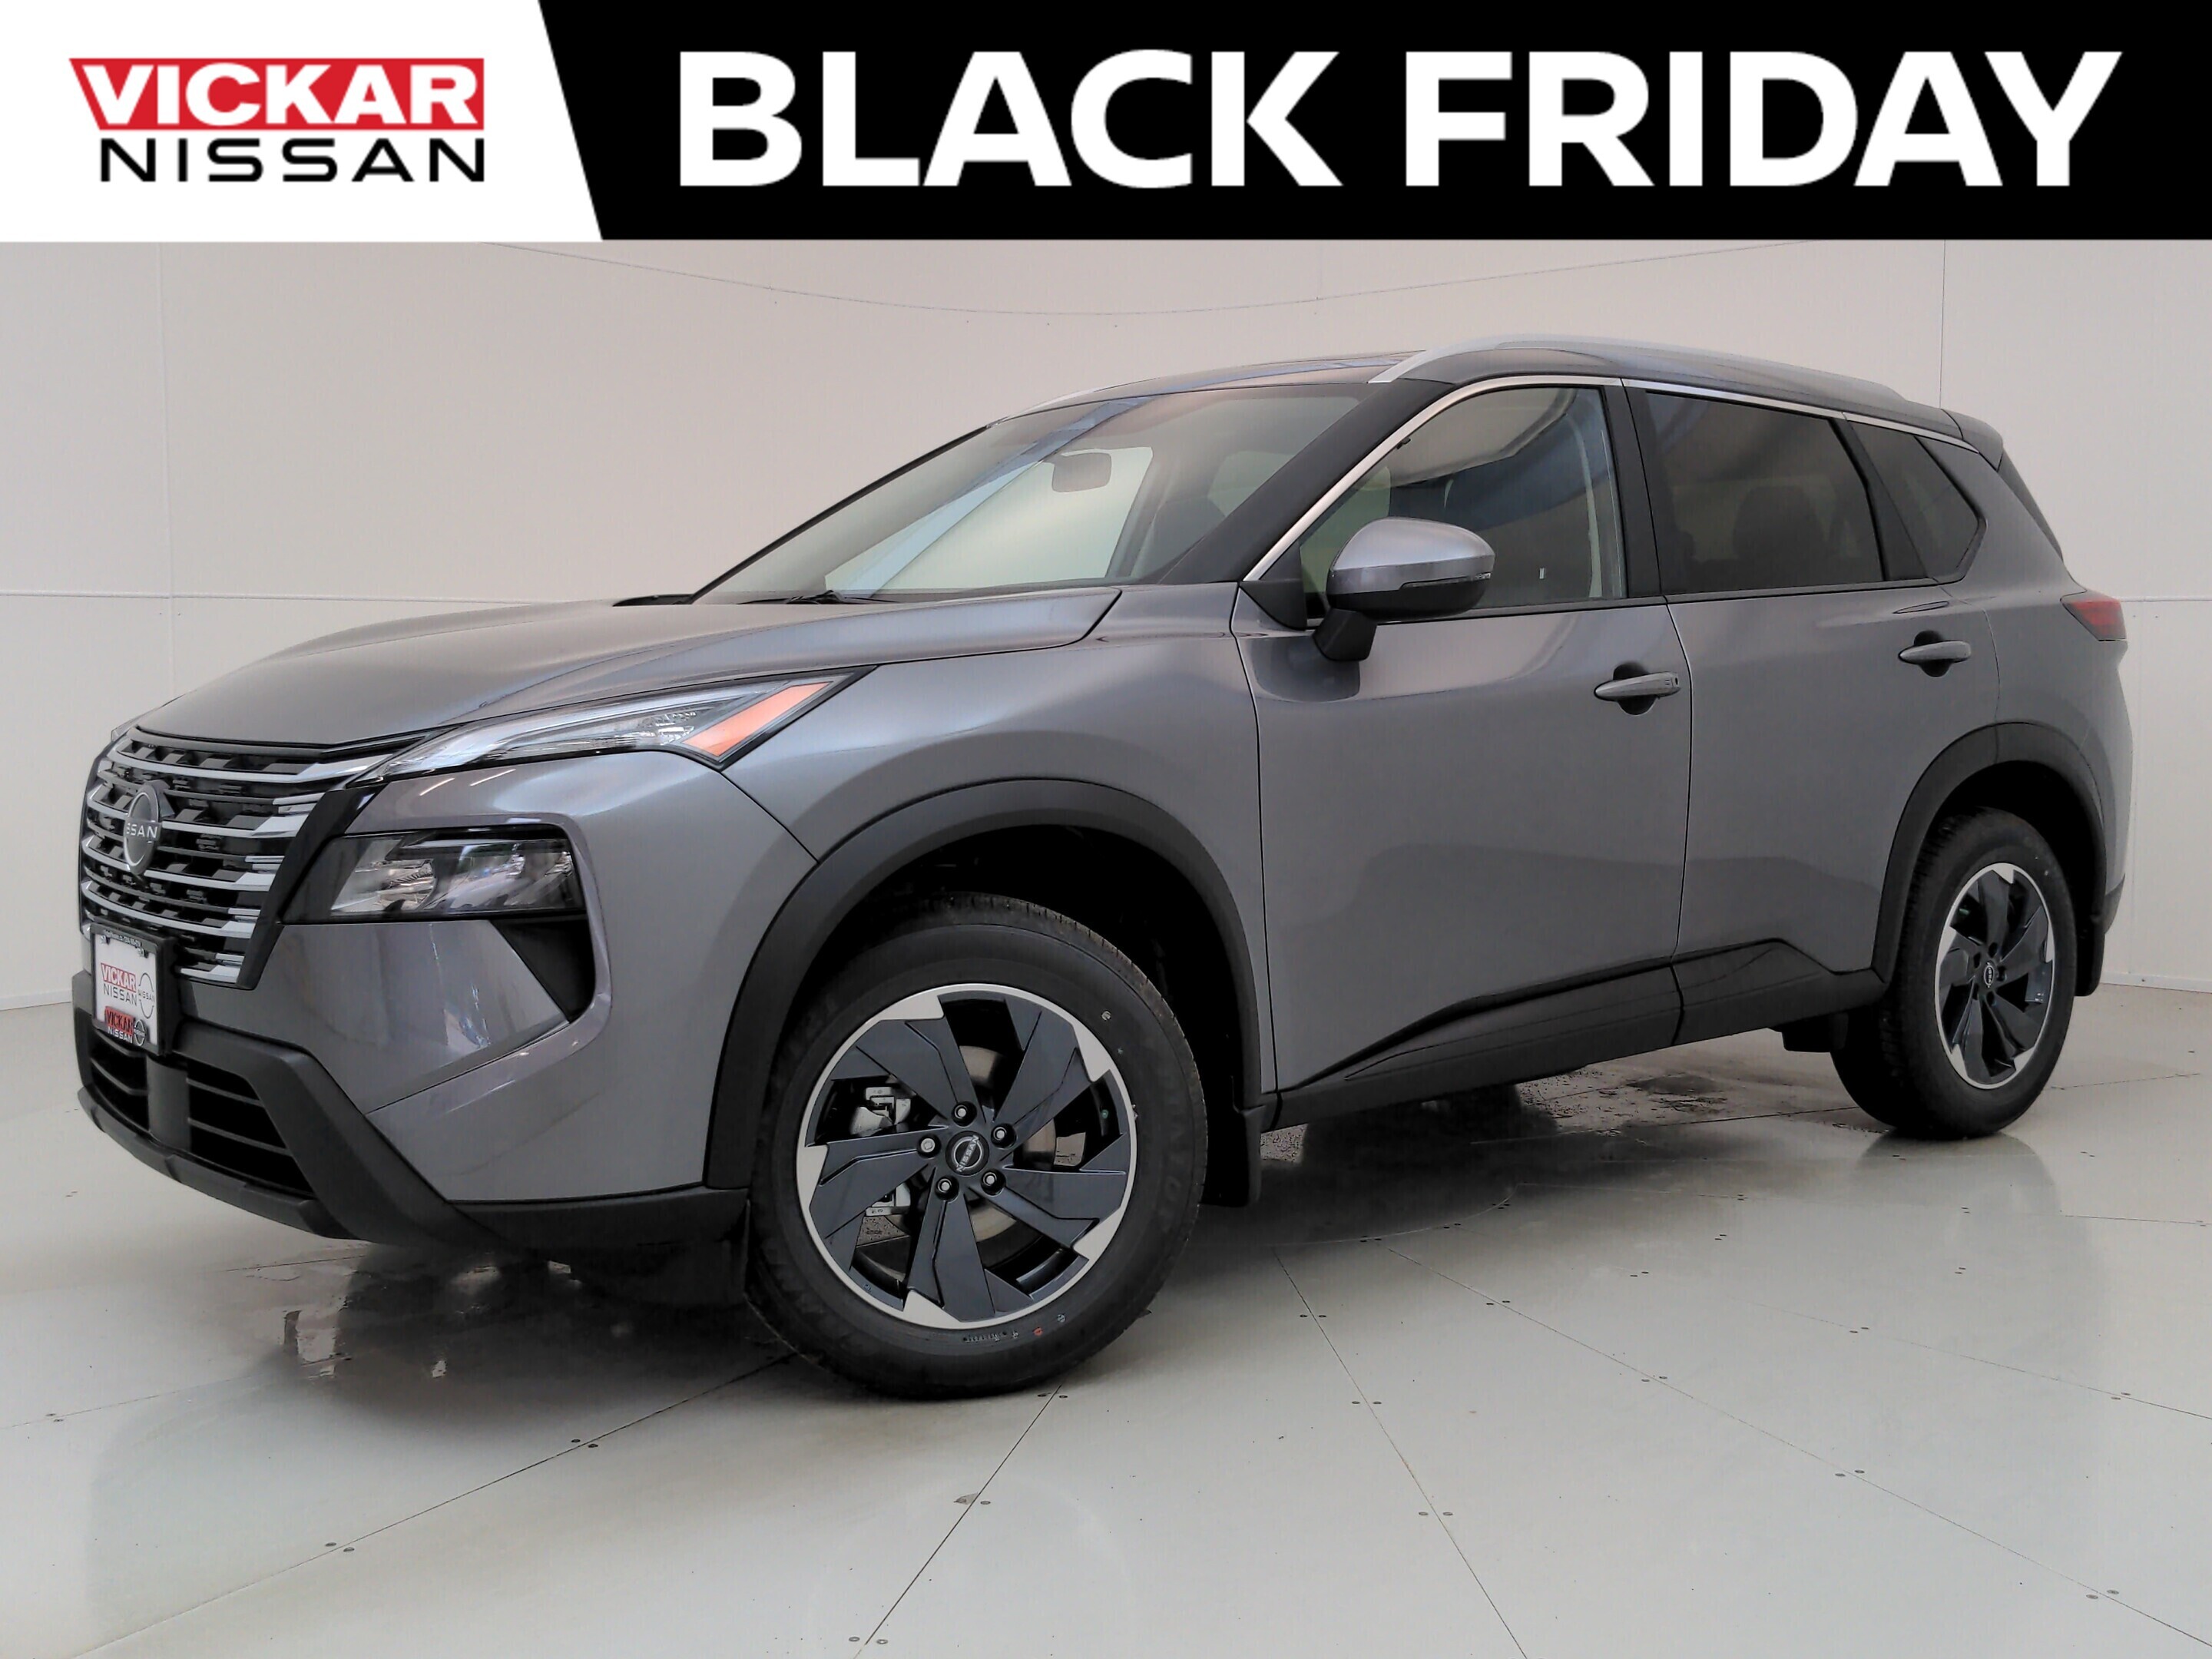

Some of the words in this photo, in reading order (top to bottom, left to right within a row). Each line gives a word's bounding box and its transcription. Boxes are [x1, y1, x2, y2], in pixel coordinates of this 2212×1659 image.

[101, 965, 136, 992] VICKAR
[104, 983, 137, 1006] NISSAN
[108, 1026, 133, 1043] NISSAN
[956, 1134, 979, 1172] NISSAN
